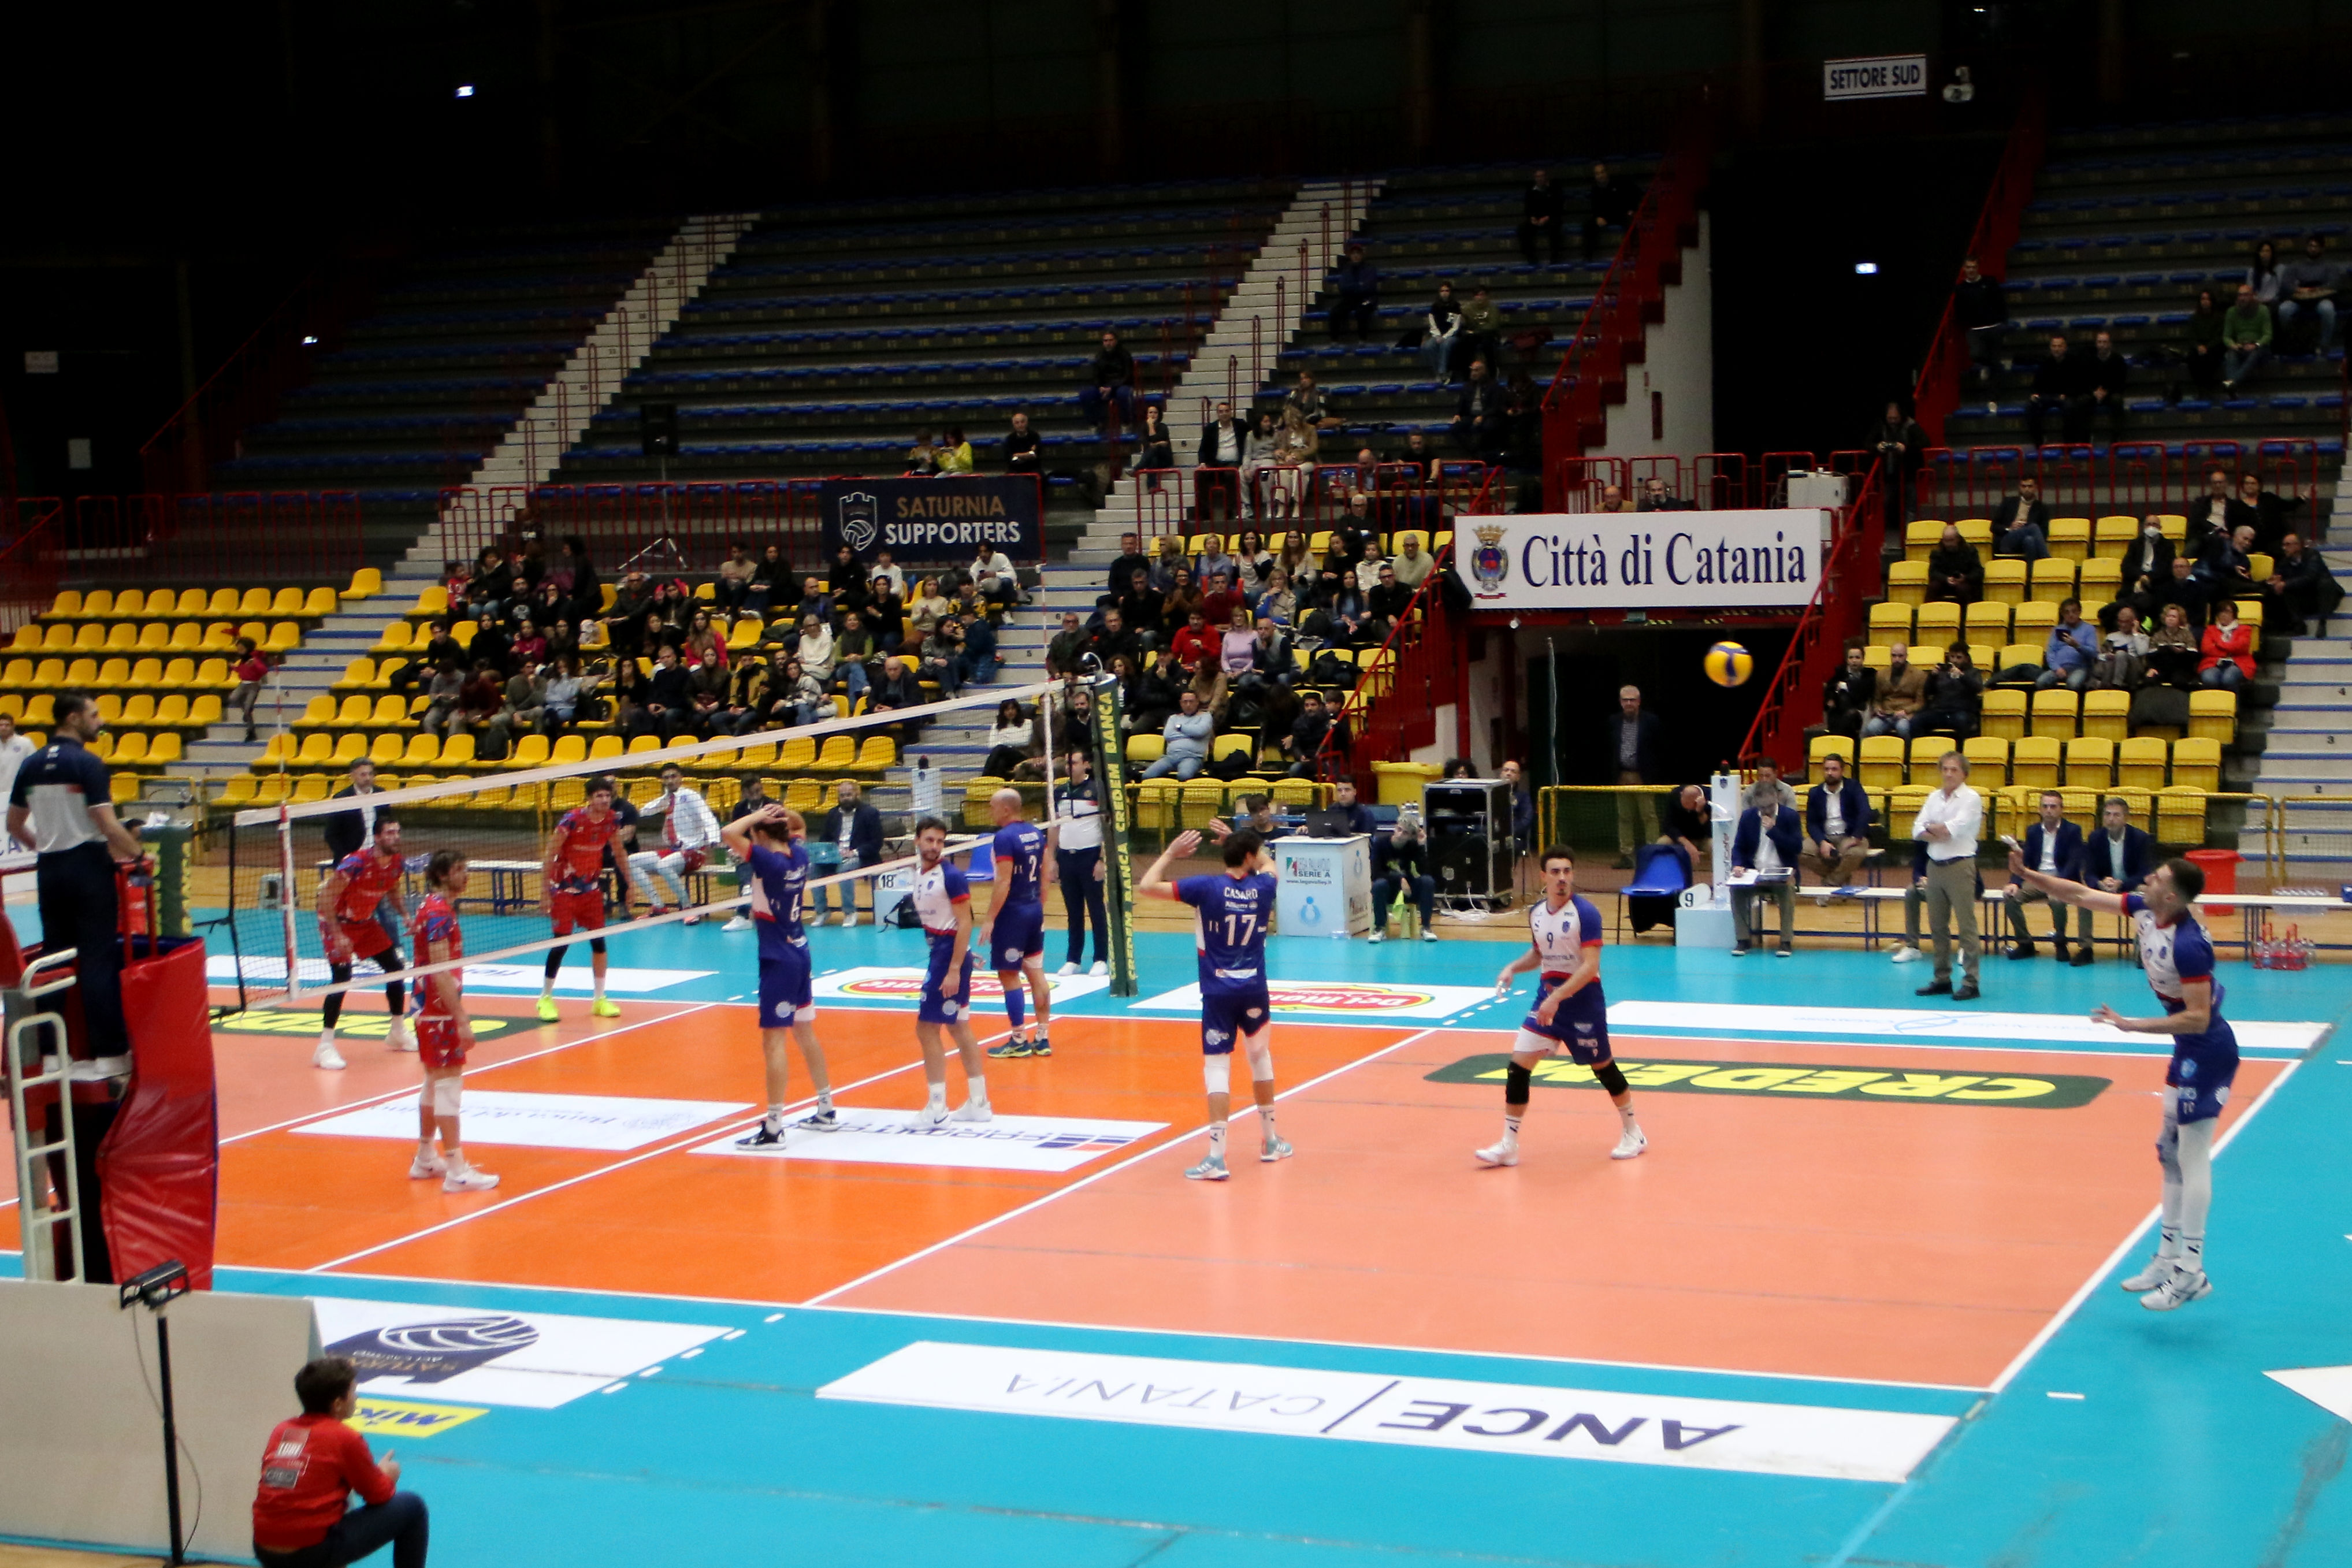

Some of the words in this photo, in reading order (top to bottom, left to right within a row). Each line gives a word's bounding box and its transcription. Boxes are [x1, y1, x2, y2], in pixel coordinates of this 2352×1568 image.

[1830, 67, 1887, 90] SETTORE
[1892, 64, 1920, 86] SUD
[896, 495, 1006, 518] SATURNIA
[884, 521, 1021, 545] SUPPORTERS
[1522, 534, 1608, 588] Città
[1620, 533, 1654, 586] di
[1666, 530, 1807, 585] Catania
[1098, 692, 1116, 755] BANCA
[1106, 762, 1127, 833] CREDEM
[881, 874, 894, 889] 18
[1028, 854, 1038, 882] 2
[1224, 886, 1258, 900] CASARO
[1685, 893, 1694, 907] 9
[790, 893, 800, 923] 6
[1224, 914, 1257, 946] 17
[1547, 932, 1554, 949] 9
[1474, 1058, 2058, 1101] CREDEM
[1008, 1372, 1327, 1417] CATANIA
[1378, 1398, 1744, 1451] ANCE
